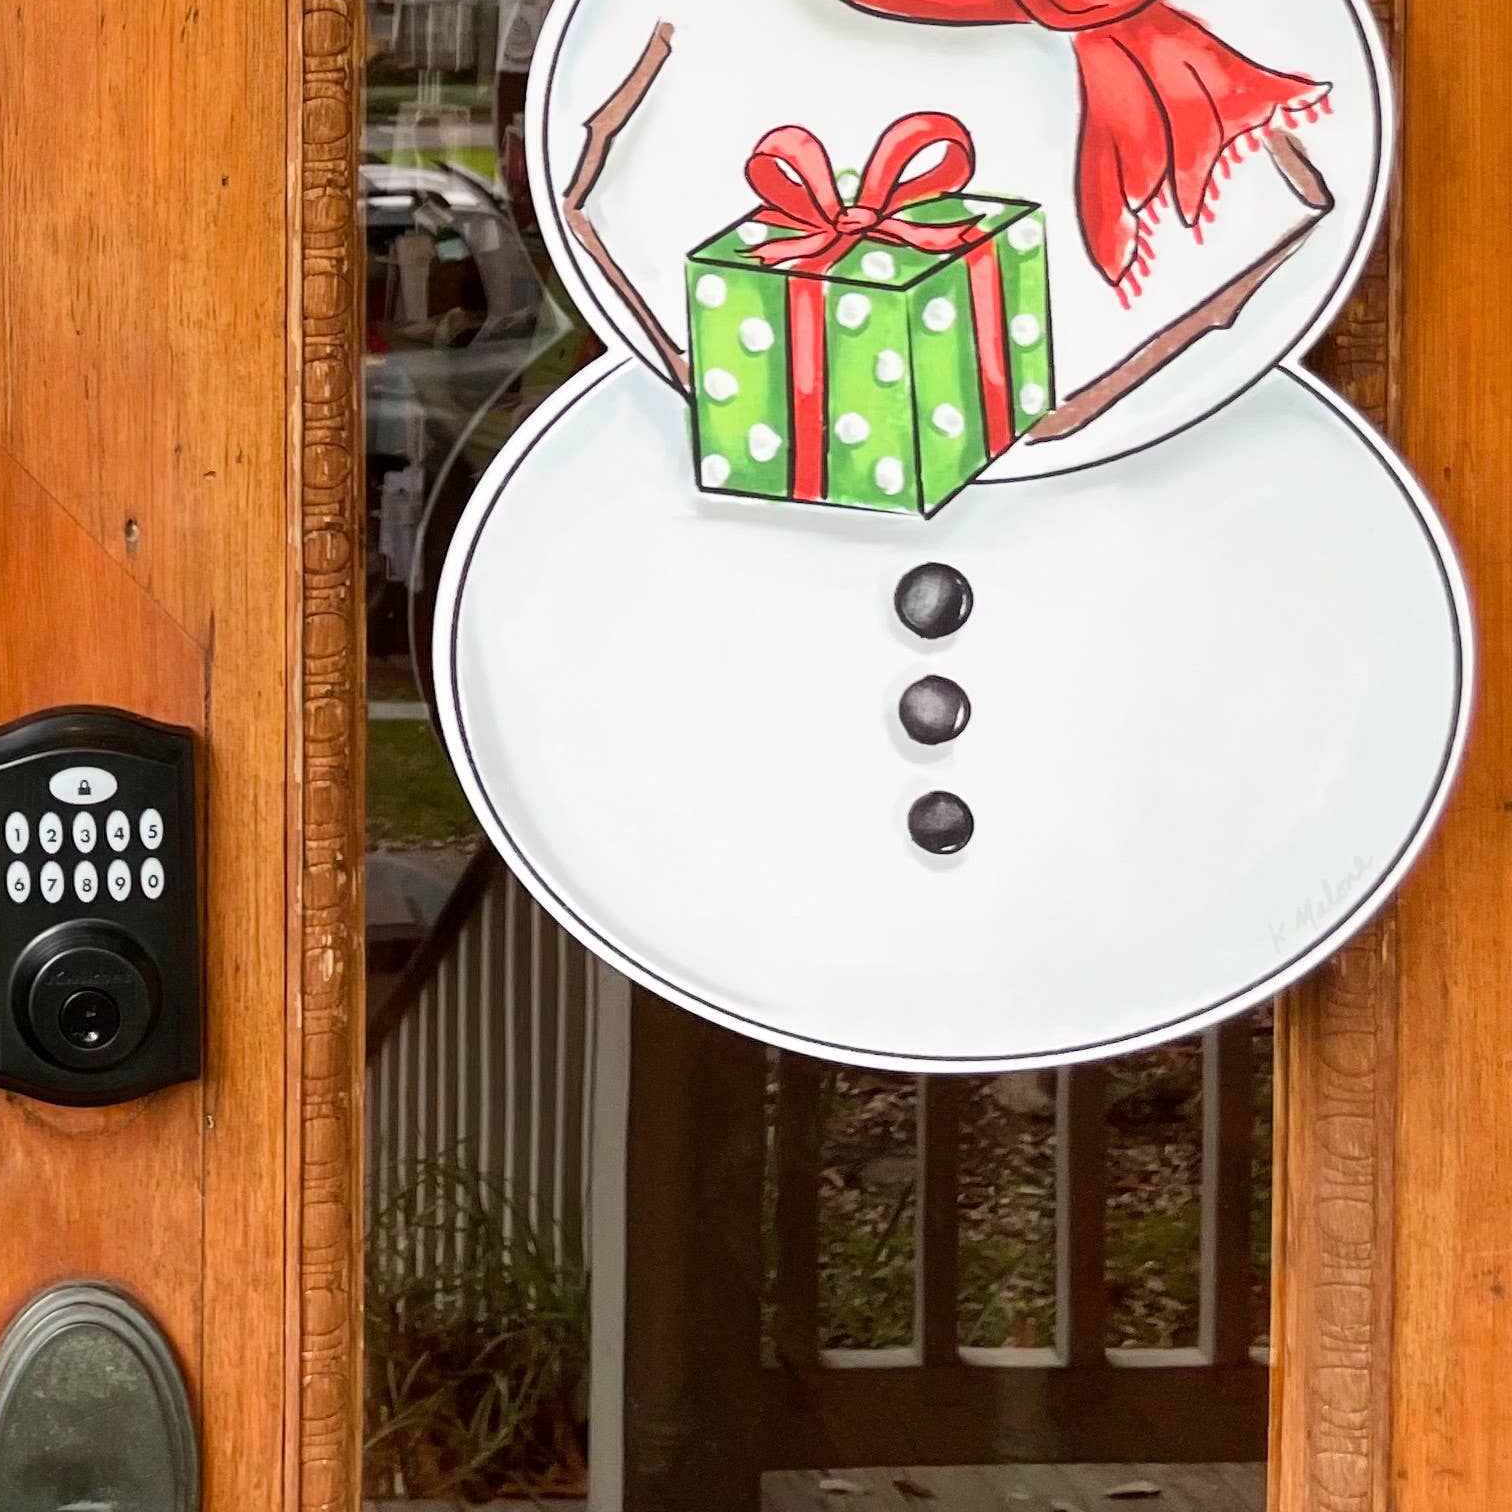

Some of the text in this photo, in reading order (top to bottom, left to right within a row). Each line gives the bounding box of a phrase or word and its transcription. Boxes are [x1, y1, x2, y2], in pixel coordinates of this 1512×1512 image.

[14, 824, 157, 843] 1 2 3 4 5
[14, 874, 158, 892] 6 7 8 9 0
